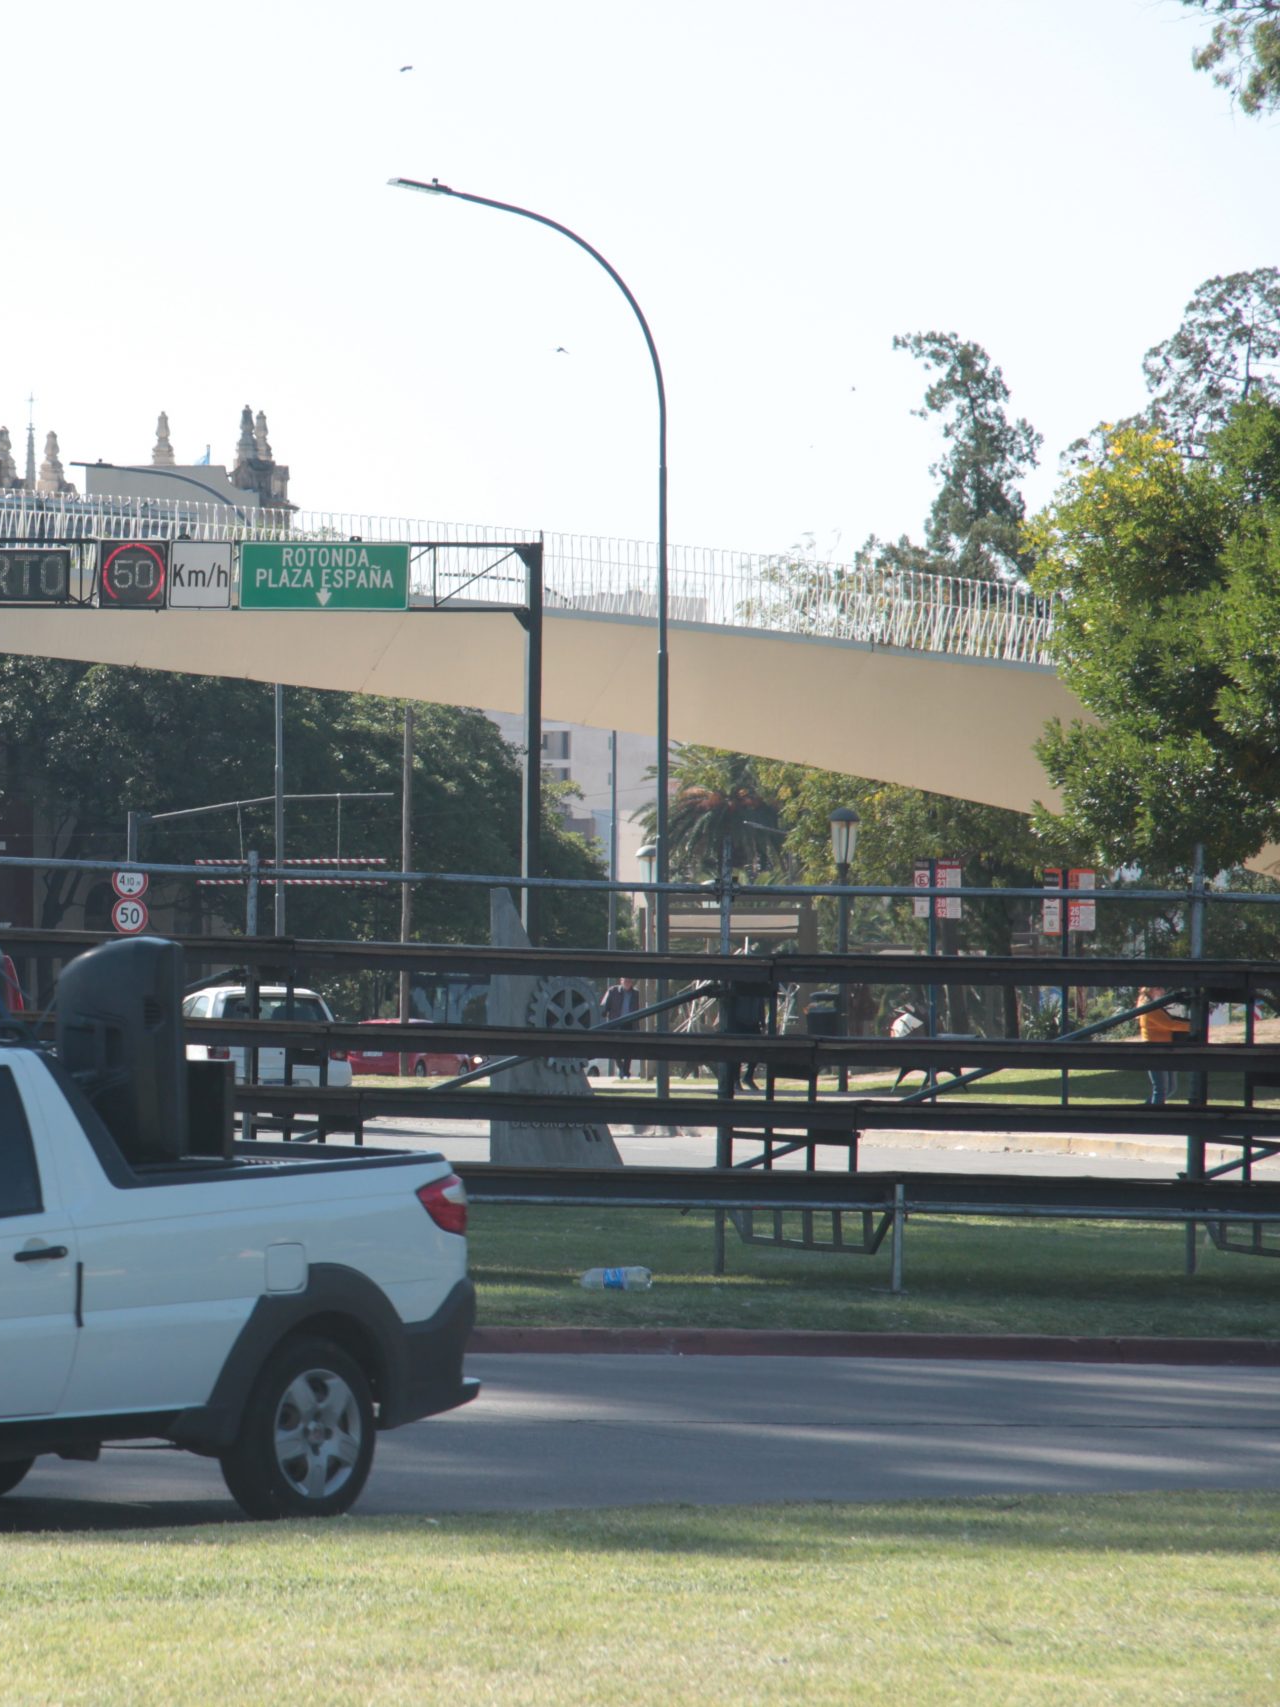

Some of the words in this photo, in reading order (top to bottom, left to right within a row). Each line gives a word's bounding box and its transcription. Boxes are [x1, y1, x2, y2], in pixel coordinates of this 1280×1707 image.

[281, 547, 369, 568] ROTONDA
[114, 559, 154, 589] 50
[172, 563, 229, 588] Km/h
[255, 568, 315, 588] PLAZA
[321, 564, 394, 589] ESPAÑA
[120, 907, 140, 925] 50
